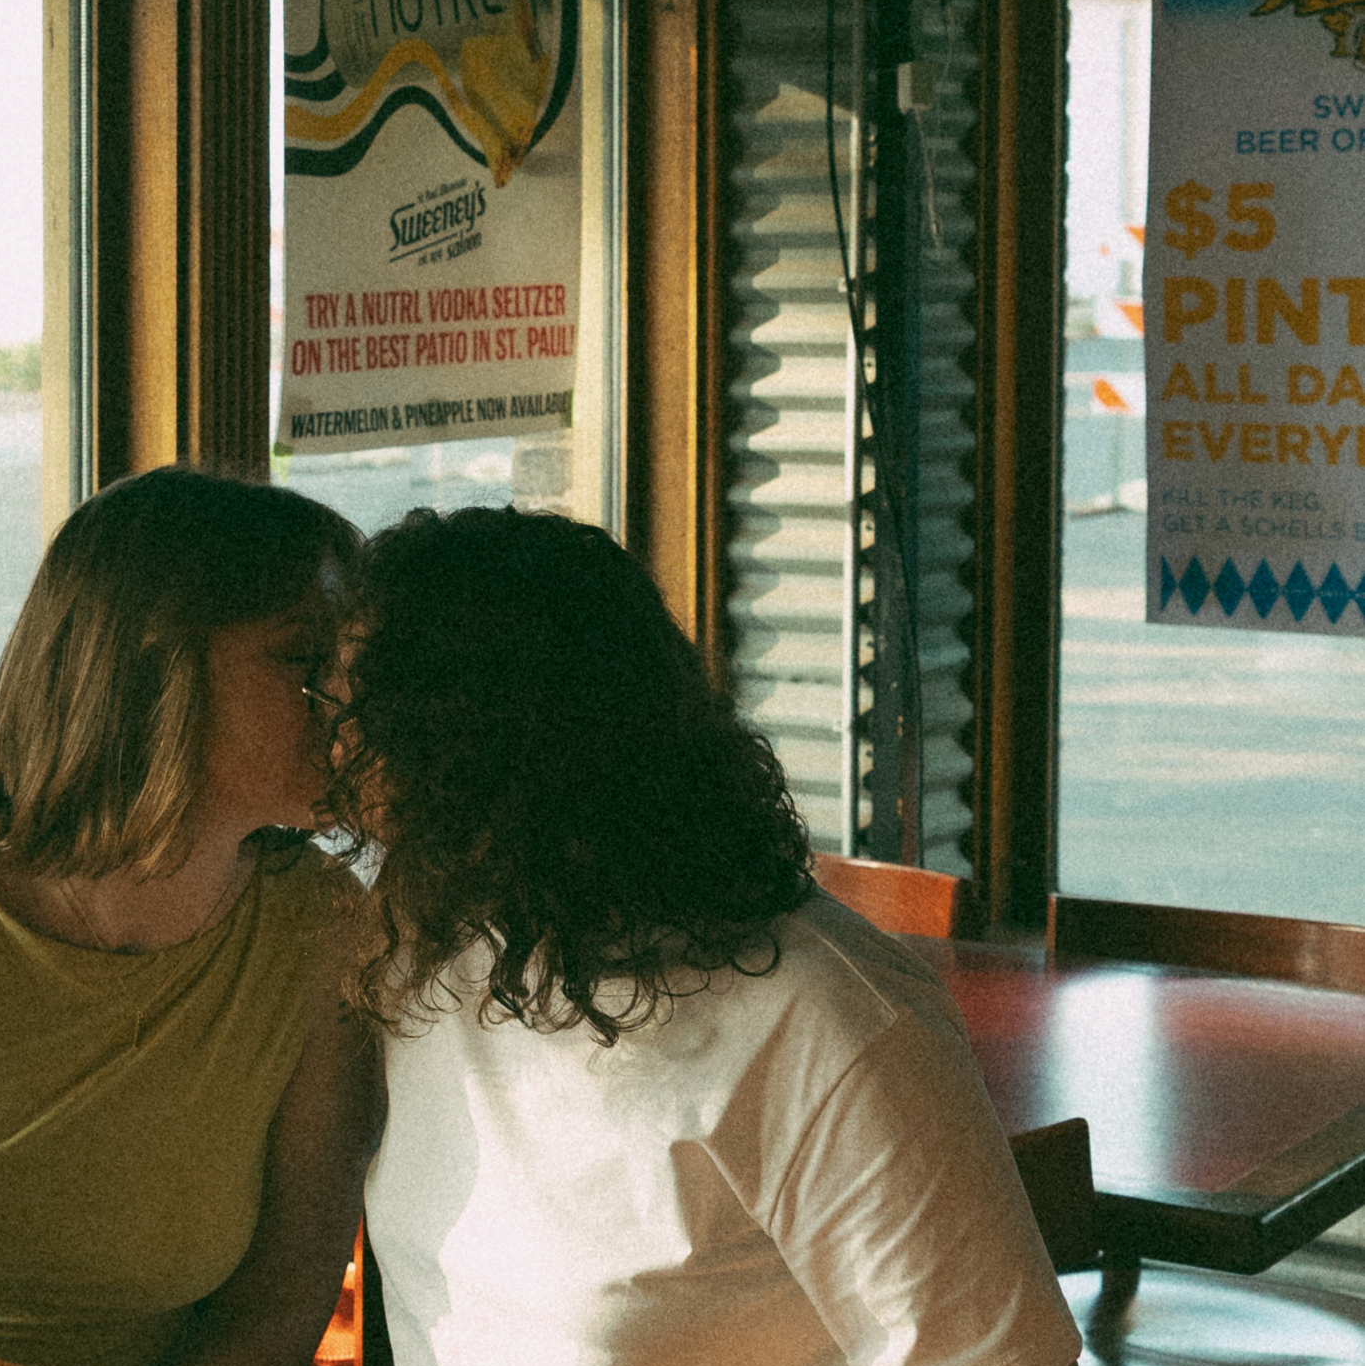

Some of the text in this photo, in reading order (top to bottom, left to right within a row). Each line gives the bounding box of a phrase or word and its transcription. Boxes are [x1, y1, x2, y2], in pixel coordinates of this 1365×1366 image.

[1236, 130, 1321, 155] BEER
[1163, 178, 1277, 261] $5
[305, 293, 340, 329] TRY
[345, 292, 357, 327] A
[426, 287, 488, 323] VODKA
[492, 284, 567, 320] SELTZER
[291, 339, 322, 376] ON
[327, 337, 361, 373] THE
[366, 334, 411, 370] BEST
[415, 330, 468, 366] PATIO
[472, 328, 492, 362] IN
[495, 327, 522, 361] ST.
[1161, 362, 1269, 404] ALL
[290, 407, 388, 439] WATERMELON
[391, 405, 404, 430] &
[406, 399, 474, 428] PINEAPPLE
[477, 396, 507, 421] NOW
[1217, 489, 1263, 509] THE
[1162, 515, 1206, 533] GET
[1216, 517, 1236, 534] A
